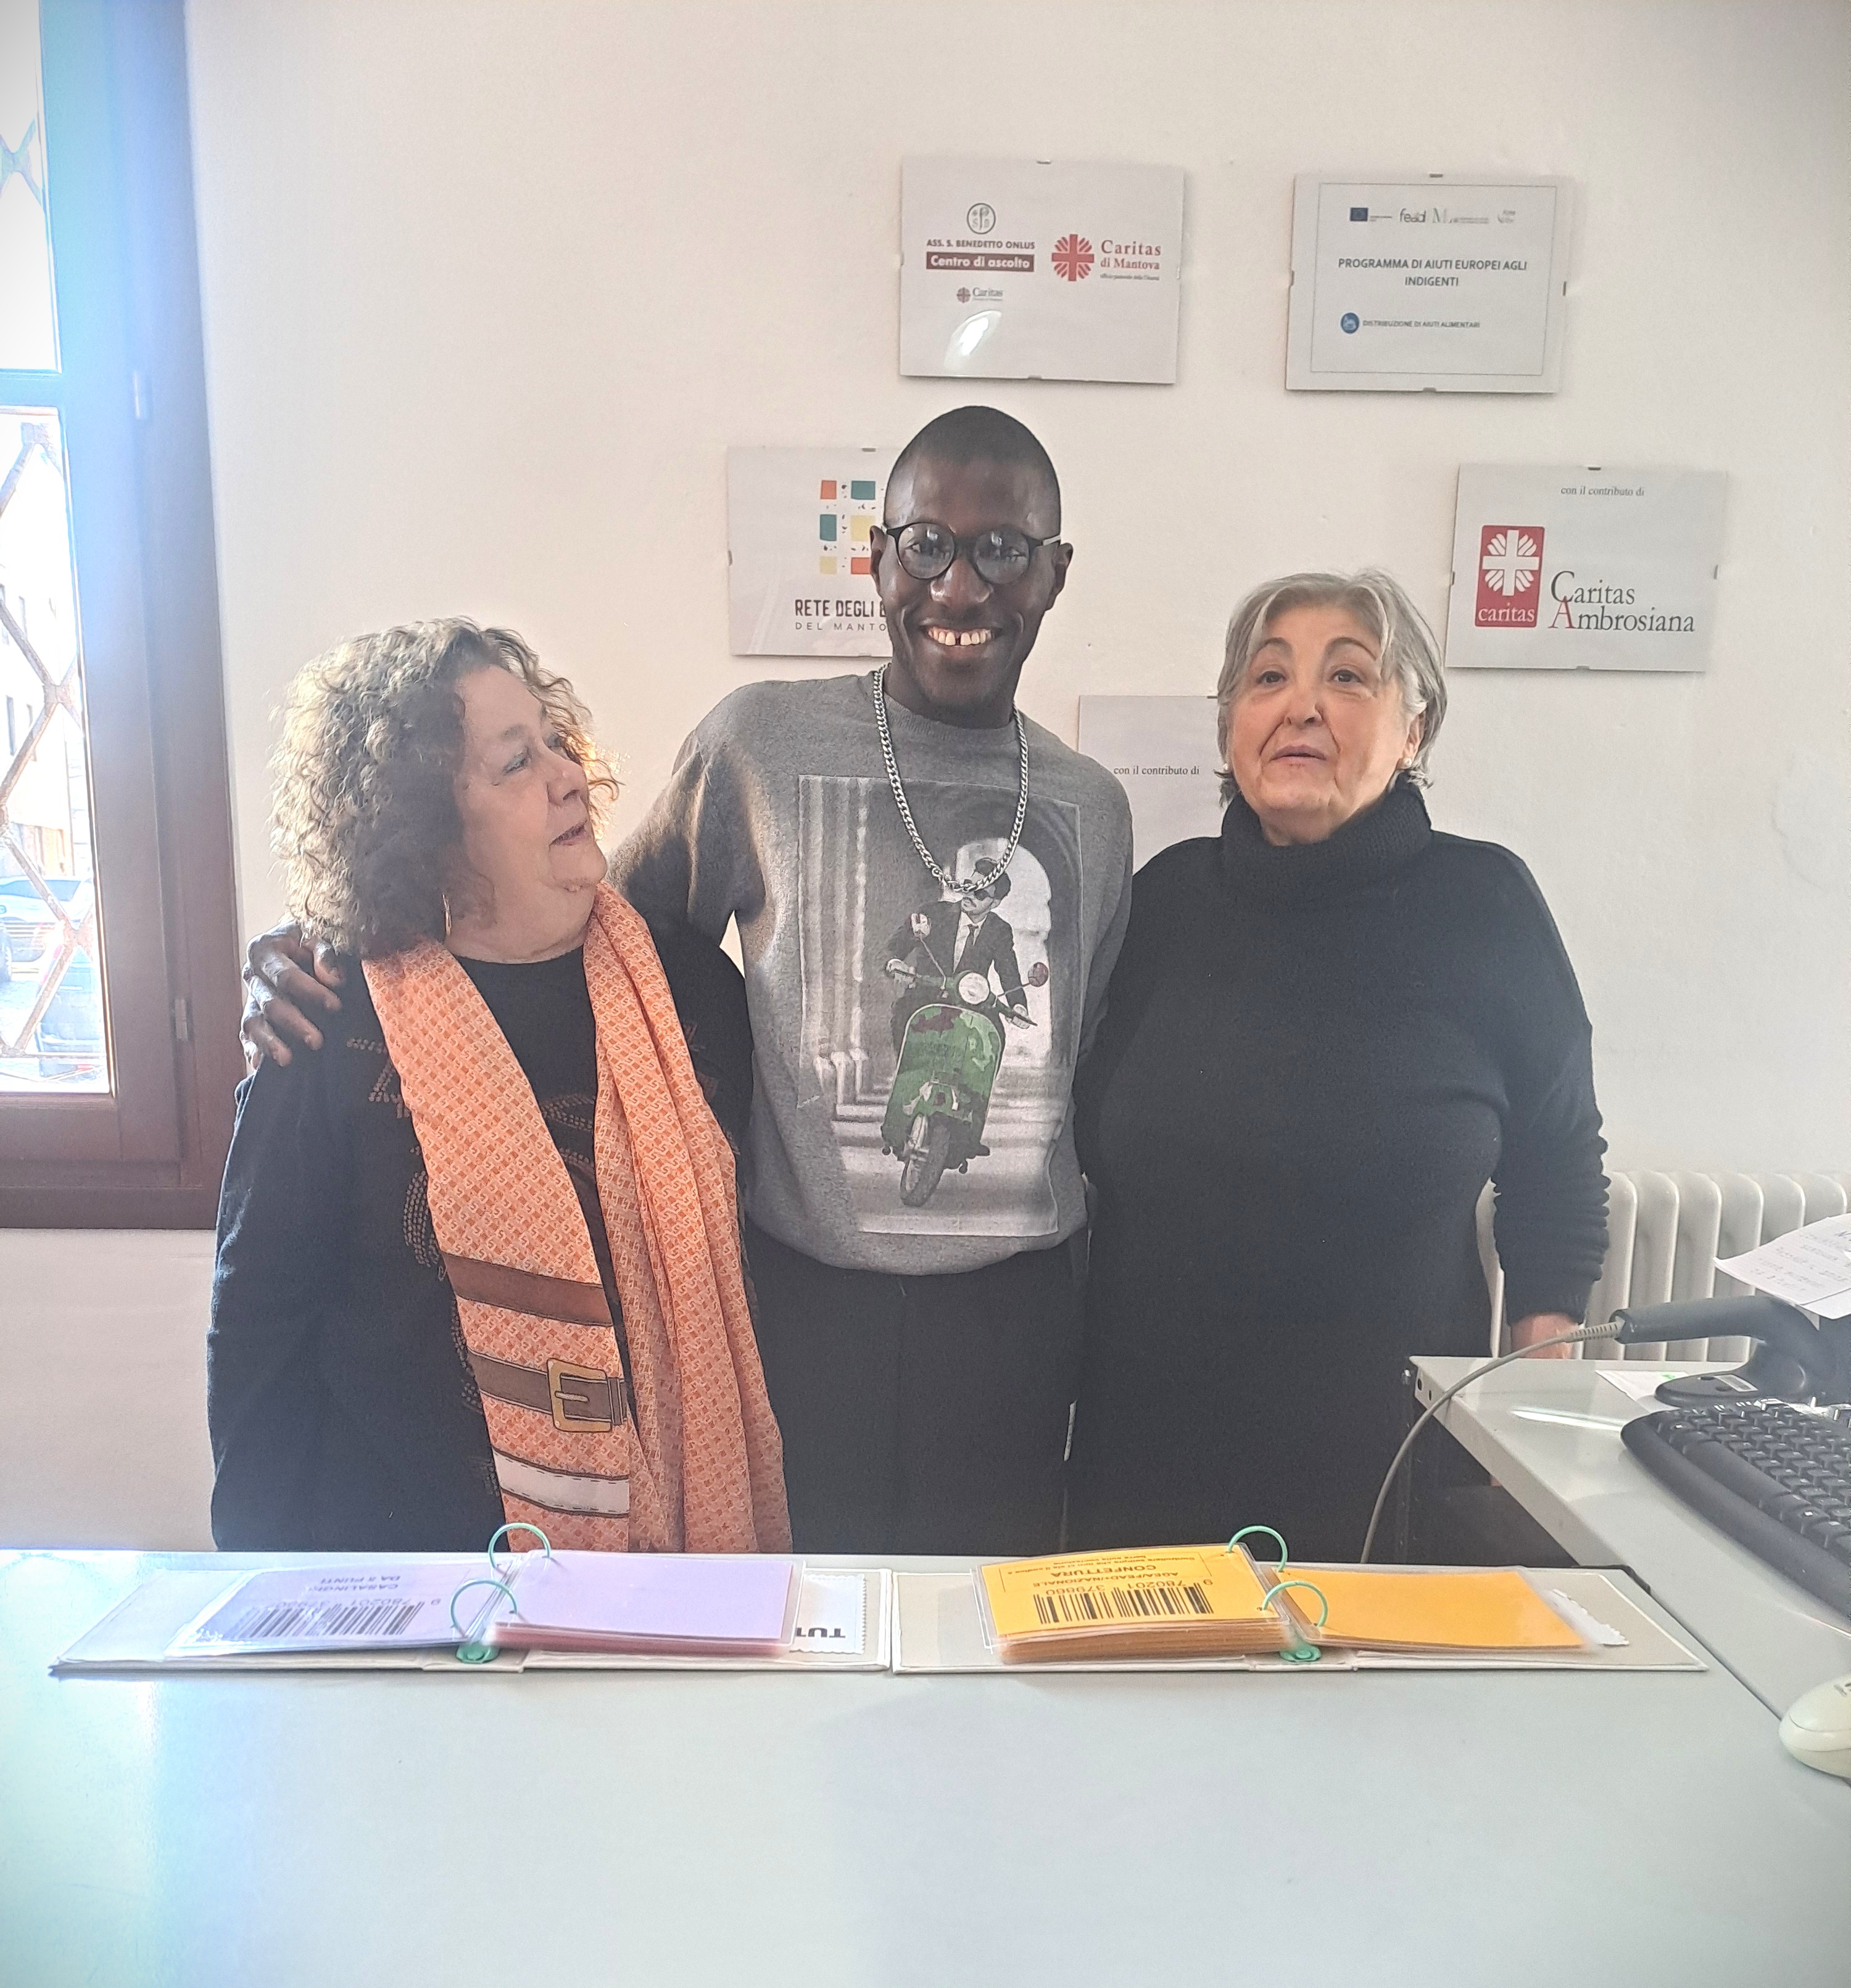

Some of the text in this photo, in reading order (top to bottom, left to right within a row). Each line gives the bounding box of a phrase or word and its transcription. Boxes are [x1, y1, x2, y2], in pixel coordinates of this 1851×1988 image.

[1399, 208, 1427, 223] fead
[926, 239, 945, 247] ASS.
[956, 239, 1003, 249] BENEDETTO
[1005, 241, 1035, 249] ONLUS
[1101, 239, 1161, 256] Caritas
[930, 254, 1030, 268] Centro di ascolto
[1100, 257, 1161, 270] di Mantova
[1338, 258, 1528, 271] PROGRAMMA DI AIUTI EUROPEI AGLI
[1404, 276, 1459, 287] INDIGENTI
[1362, 320, 1412, 328] DISTRIBUZIONE
[1580, 486, 1586, 495] il
[1588, 486, 1633, 496] contributo
[1636, 486, 1644, 496] di
[1551, 570, 1636, 605] Caritas
[795, 599, 830, 616] RETE
[835, 600, 874, 618] DEGLI
[1477, 602, 1536, 623] caritas
[1548, 596, 1696, 632] Ambrosiana
[795, 622, 887, 632] DEL MANTO
[1113, 765, 1199, 776] con il contributo di
[1051, 1565, 1157, 1577] CONFETTURA
[796, 1627, 846, 1639] TUT
